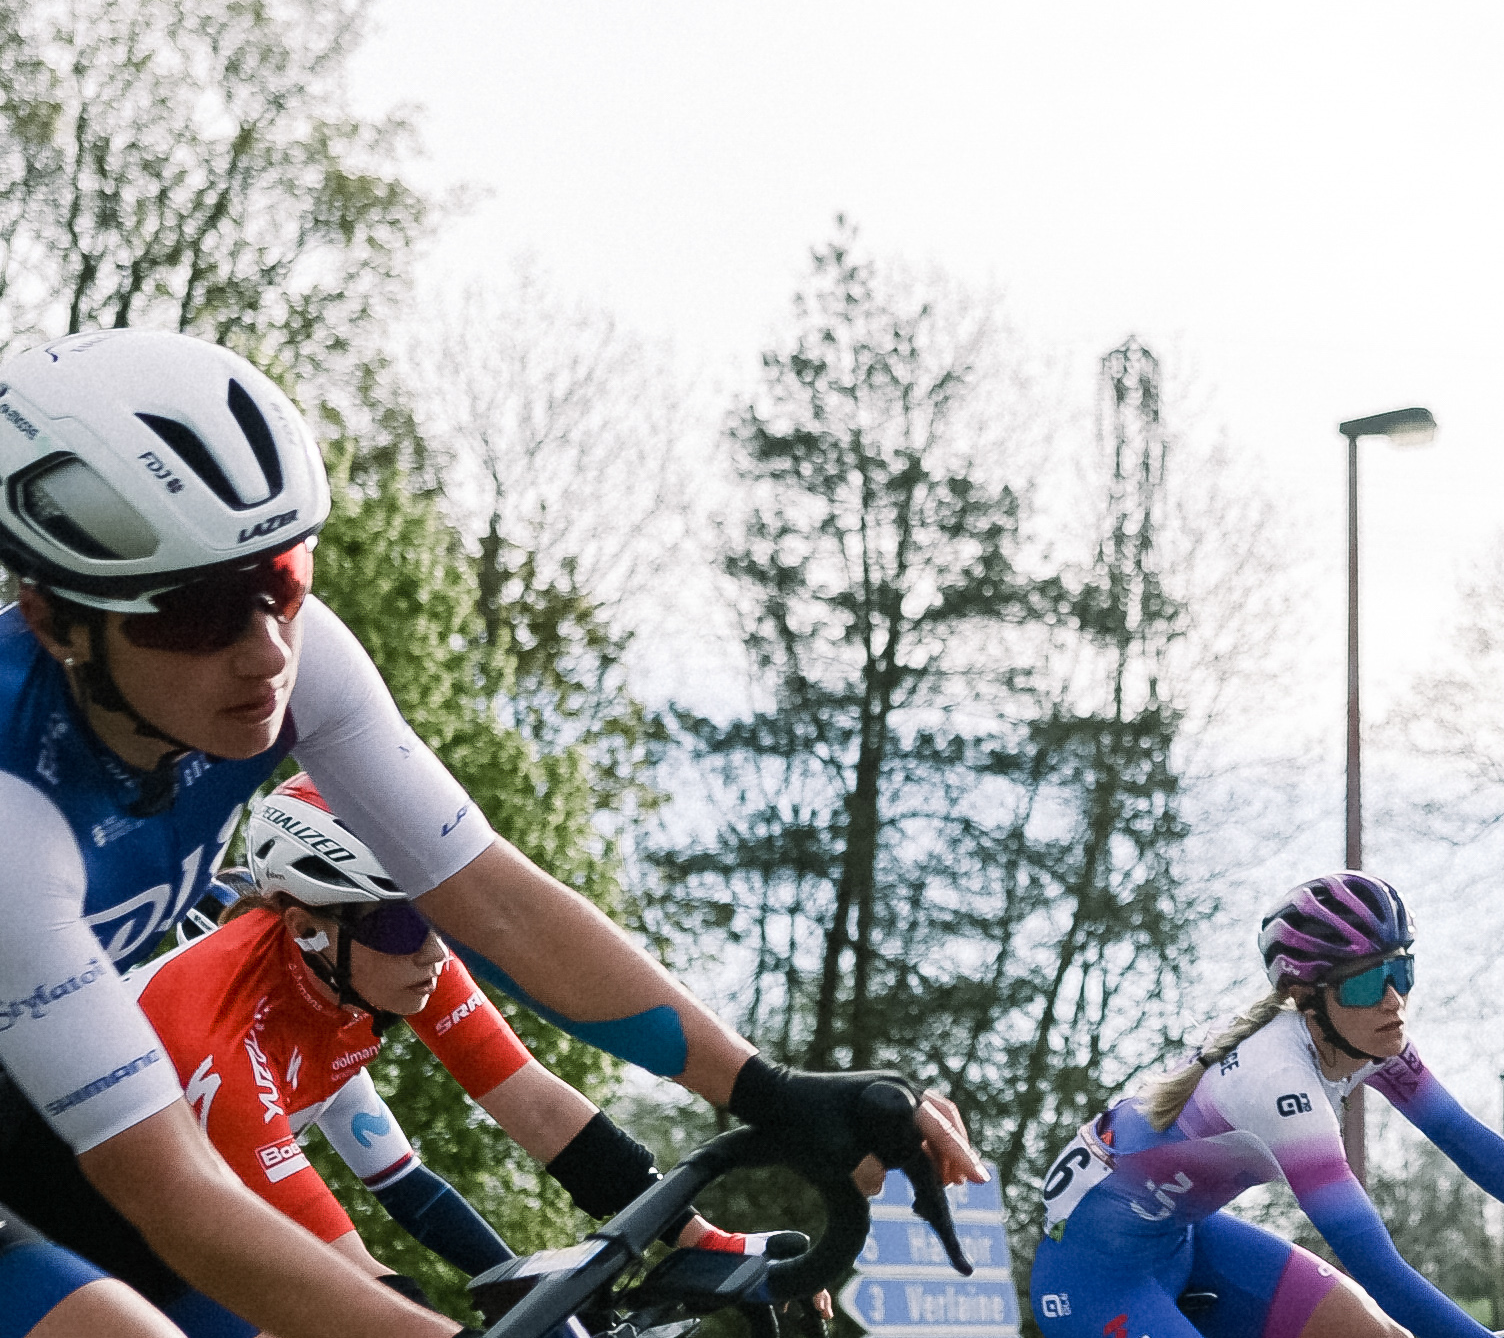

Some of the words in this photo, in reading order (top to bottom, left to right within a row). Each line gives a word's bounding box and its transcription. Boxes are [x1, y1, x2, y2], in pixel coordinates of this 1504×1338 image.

[260, 805, 358, 863] PECIALIZED
[434, 990, 486, 1037] SRA
[904, 1283, 1005, 1323] Verlaine
